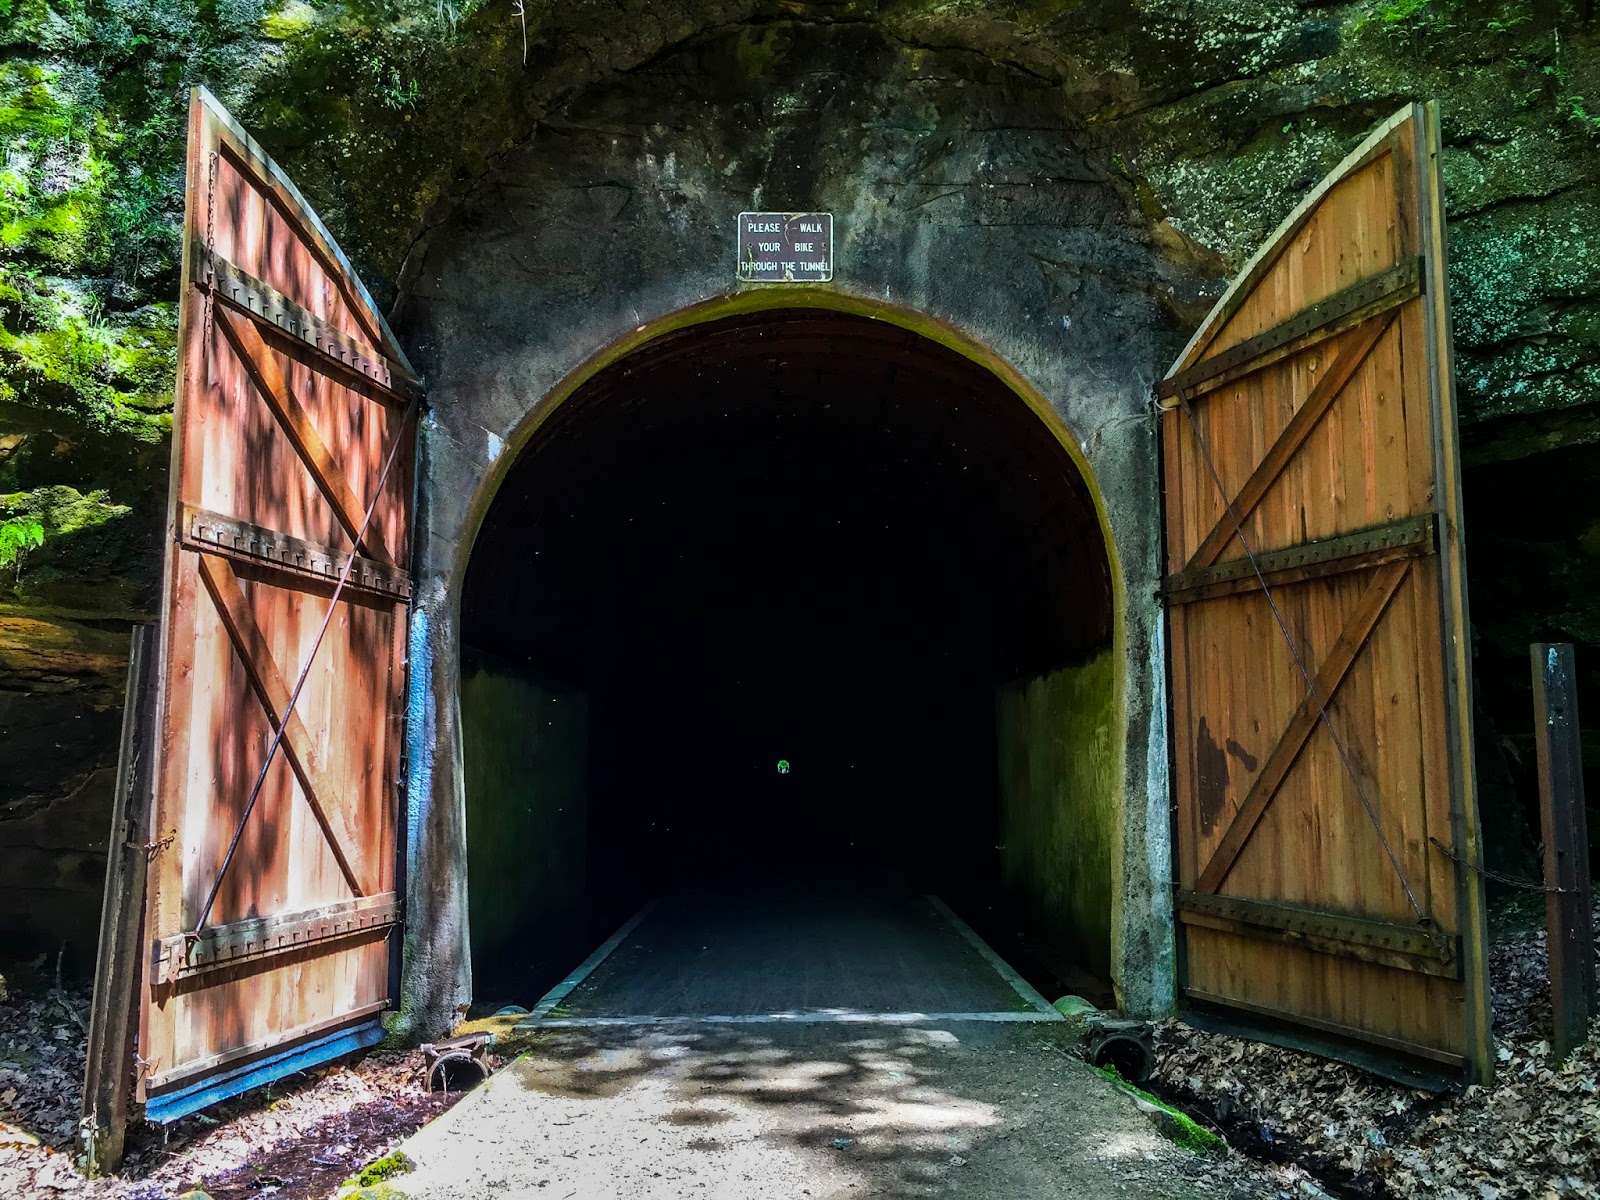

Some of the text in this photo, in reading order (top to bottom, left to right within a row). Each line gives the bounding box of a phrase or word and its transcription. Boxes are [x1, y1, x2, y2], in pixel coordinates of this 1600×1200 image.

[748, 223, 822, 233] PLEASE WALK
[758, 242, 814, 252] YOUR BIKE
[741, 261, 830, 271] THROUGH THE TUNNEL
